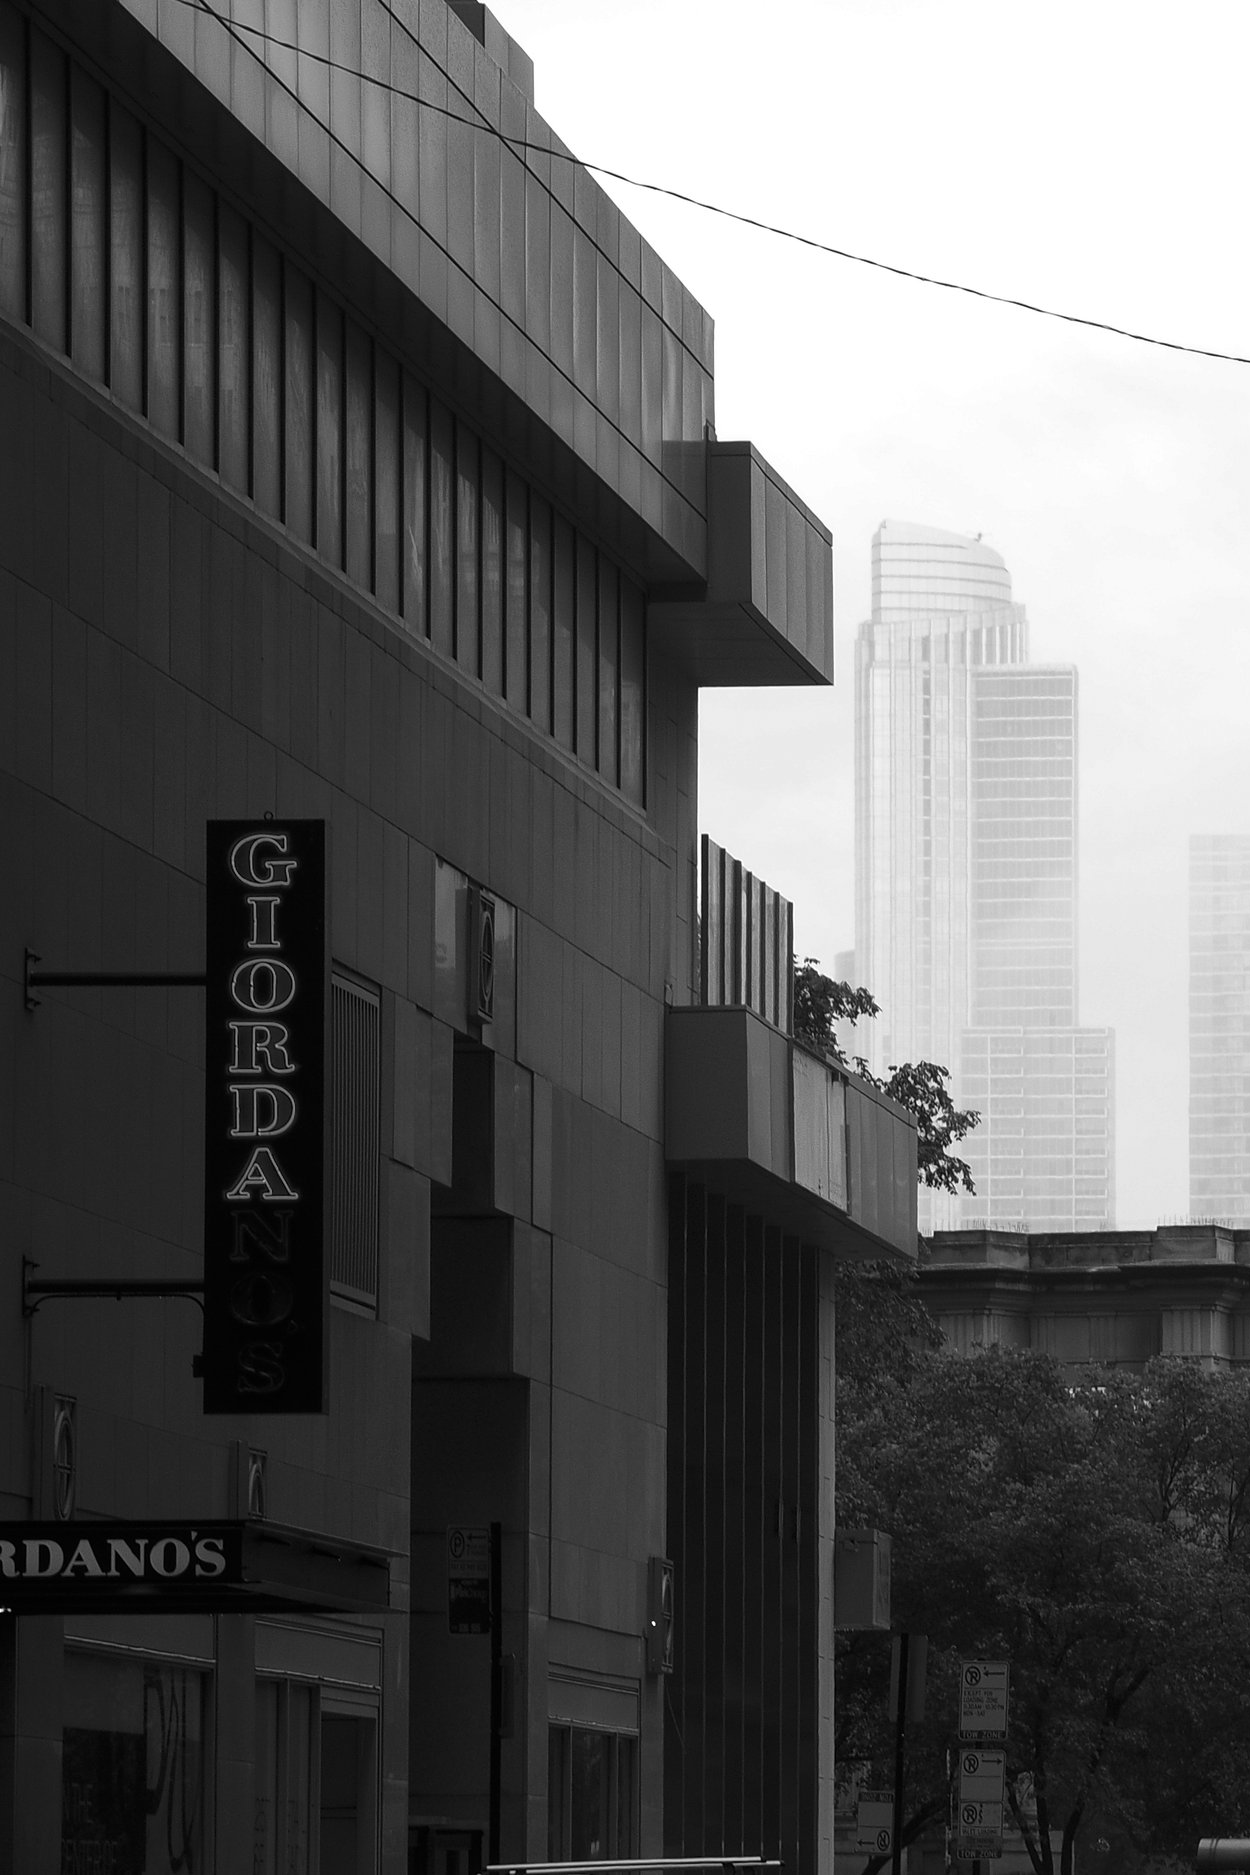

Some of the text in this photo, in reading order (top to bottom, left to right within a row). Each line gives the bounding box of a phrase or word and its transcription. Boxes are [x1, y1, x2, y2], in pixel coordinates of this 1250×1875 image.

[227, 834, 299, 1393] GIORDANO'S
[961, 1850, 998, 1858] TOW ZONE
